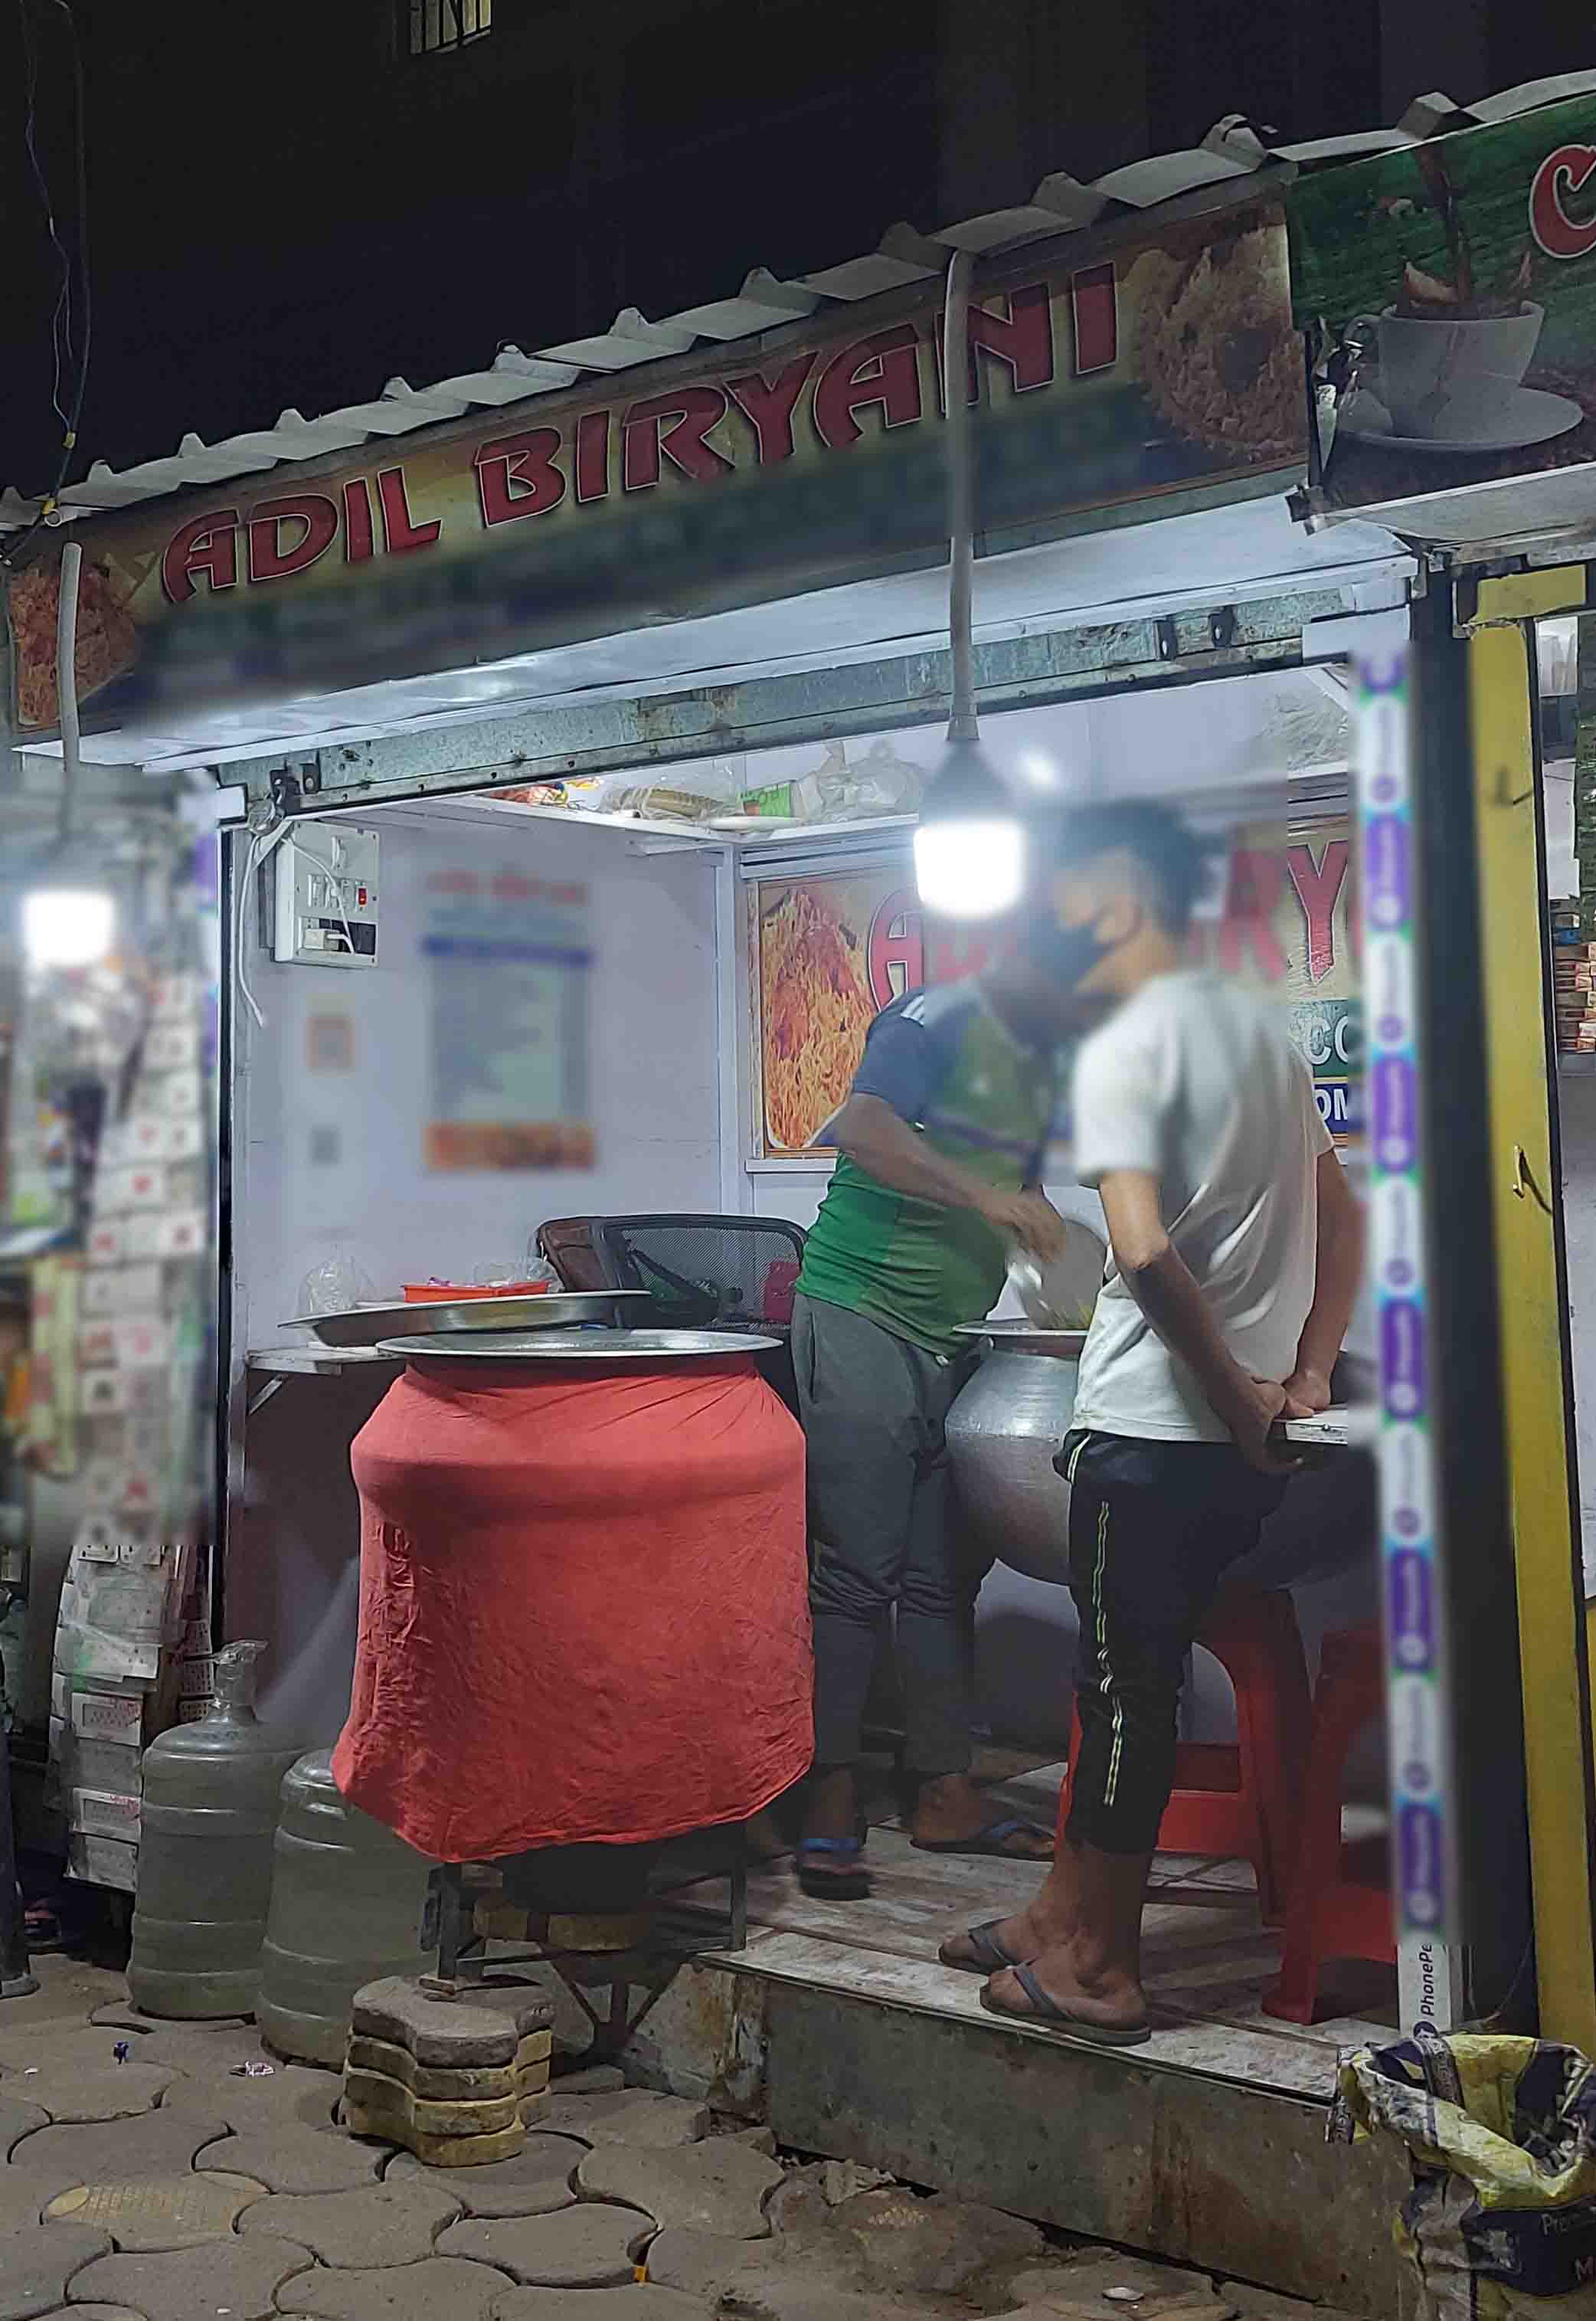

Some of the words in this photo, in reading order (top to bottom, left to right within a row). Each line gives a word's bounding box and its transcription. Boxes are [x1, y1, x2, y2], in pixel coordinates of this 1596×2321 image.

[161, 465, 442, 604] ADIL
[473, 260, 1120, 529] BIRYANI
[1418, 1943, 1435, 2018] PhonePe
